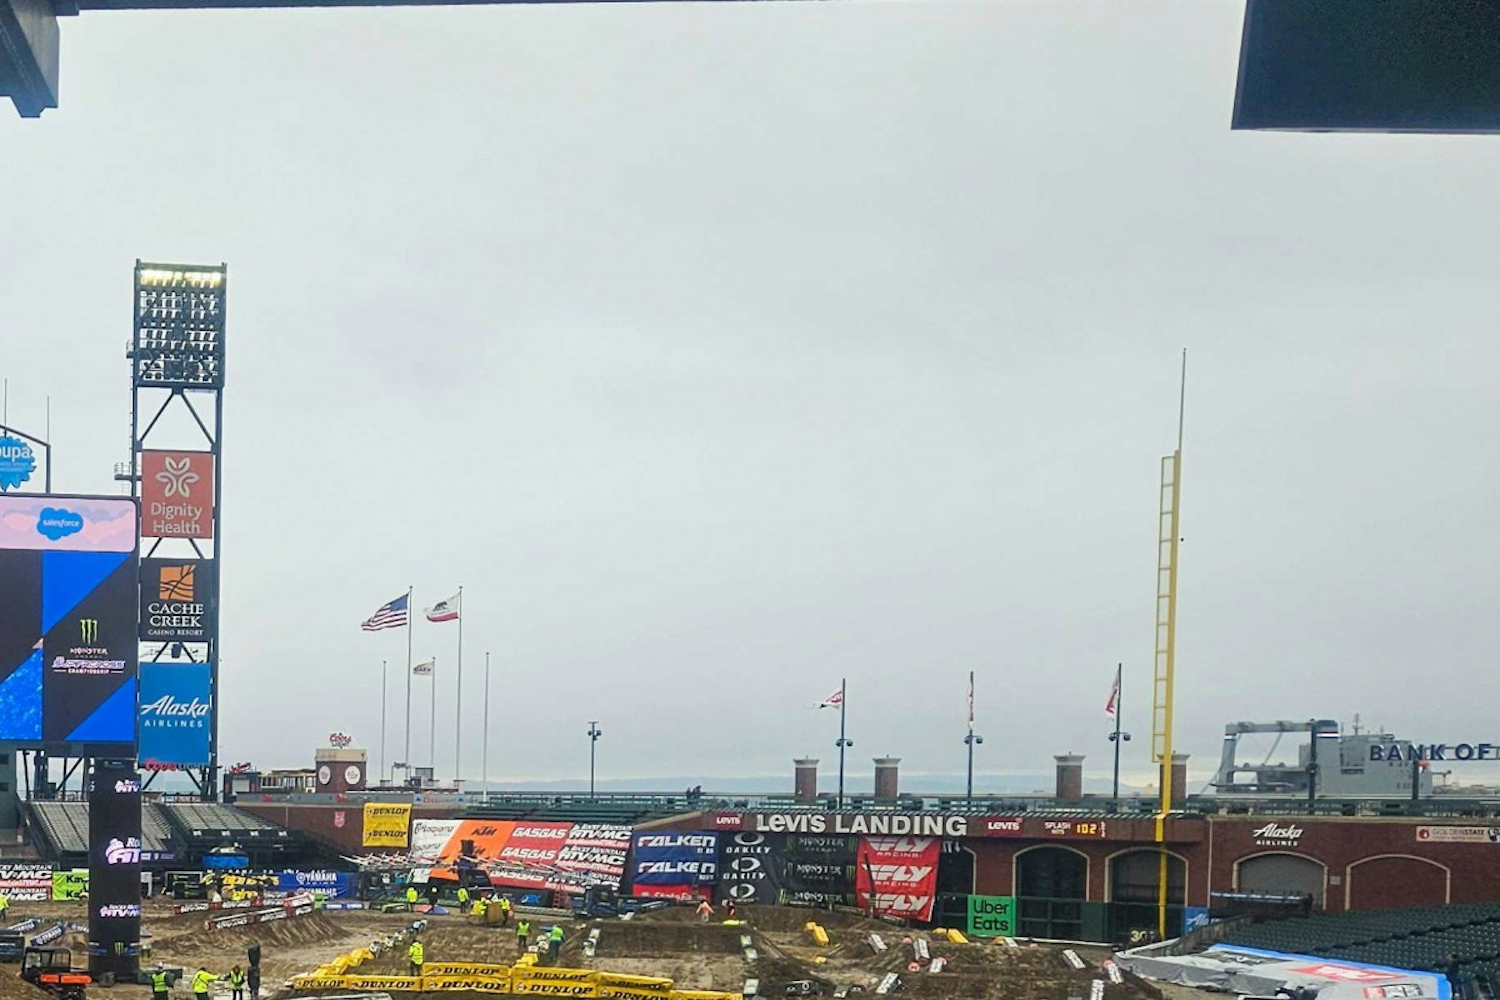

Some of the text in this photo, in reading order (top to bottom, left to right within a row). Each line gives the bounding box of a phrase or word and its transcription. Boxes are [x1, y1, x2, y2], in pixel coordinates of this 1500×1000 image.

[151, 502, 202, 519] Dignity
[42, 518, 80, 529] salesforce
[153, 520, 200, 535] Health
[148, 603, 204, 615] CACHE
[150, 616, 202, 628] CREEK
[141, 695, 209, 718] Alaska
[144, 719, 203, 728] AIRLINES
[1370, 742, 1492, 761] BANK OF
[371, 807, 408, 816] DUNLOP
[835, 815, 967, 836] LANDING
[1045, 821, 1071, 829] SPLASH
[1076, 824, 1098, 834] 102
[371, 829, 407, 838] DUNLOP
[472, 826, 497, 836] KTM
[512, 827, 566, 838] GASGAS
[1253, 823, 1303, 839] Alaska
[637, 835, 716, 847] FALKEN
[799, 837, 843, 847] MONSTER
[501, 848, 555, 860] GASGAS
[725, 846, 770, 854] OAKLEY
[12, 863, 53, 871] MOUNTAIN
[637, 861, 716, 874] FALKEN
[306, 871, 337, 881] YAMAHA
[722, 872, 765, 880] OAKLEY
[973, 900, 1009, 915] Uber
[973, 917, 1008, 931] Eats
[302, 980, 346, 988] DUNLOP
[361, 980, 415, 989] DUNLOP
[441, 981, 507, 990] DUNLOP
[529, 984, 594, 995] DUNLOP
